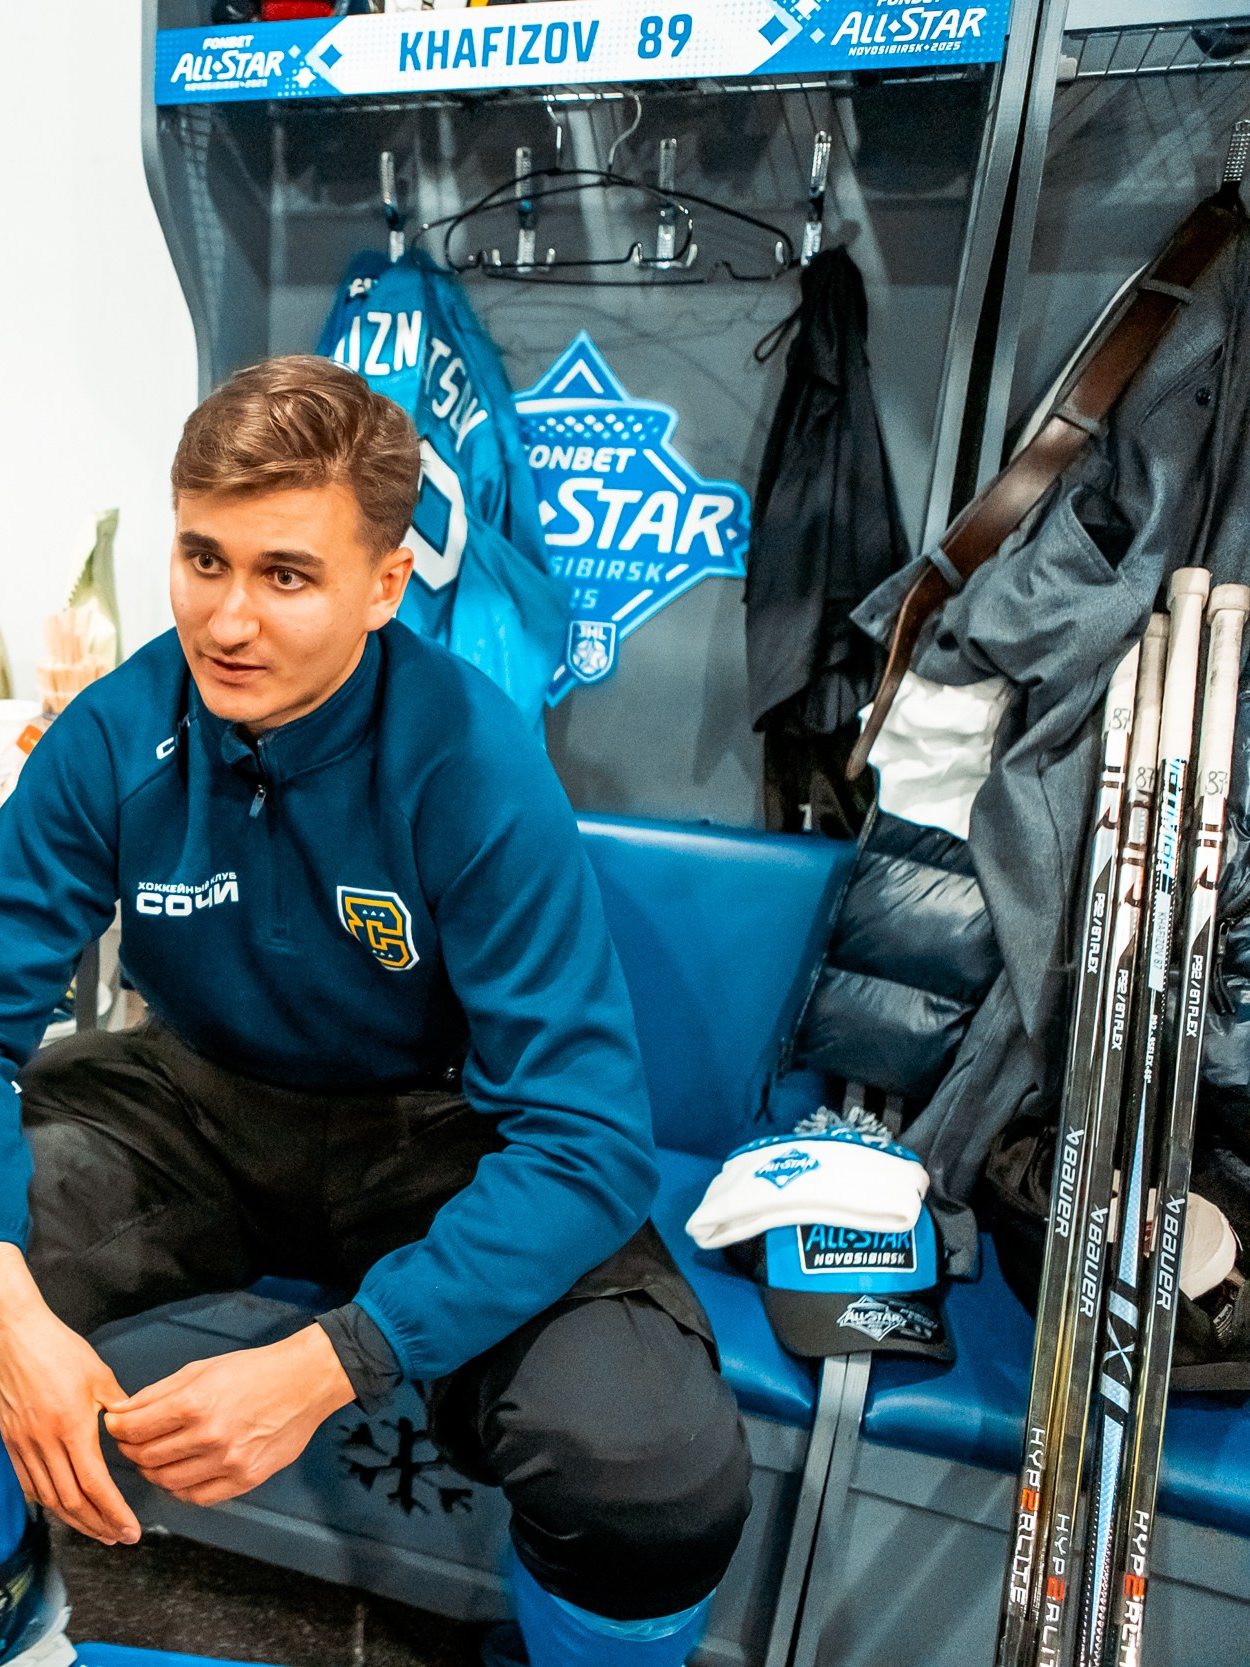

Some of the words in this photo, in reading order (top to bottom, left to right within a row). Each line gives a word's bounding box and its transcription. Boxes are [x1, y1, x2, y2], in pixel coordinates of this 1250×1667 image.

[399, 20, 600, 72] KHAFIZOV
[637, 13, 693, 59] 89
[847, 43, 924, 57] NOVOSIBIRSK
[930, 41, 962, 52] 2025
[524, 444, 637, 474] ONBET
[137, 880, 210, 894] ХОККЕЙНЫЙ
[210, 871, 237, 885] КЛУБ
[136, 881, 239, 917] СОЧИ
[1155, 911, 1167, 957] KHAFIZOV
[813, 1252, 906, 1267] NOVOSIBIRSK
